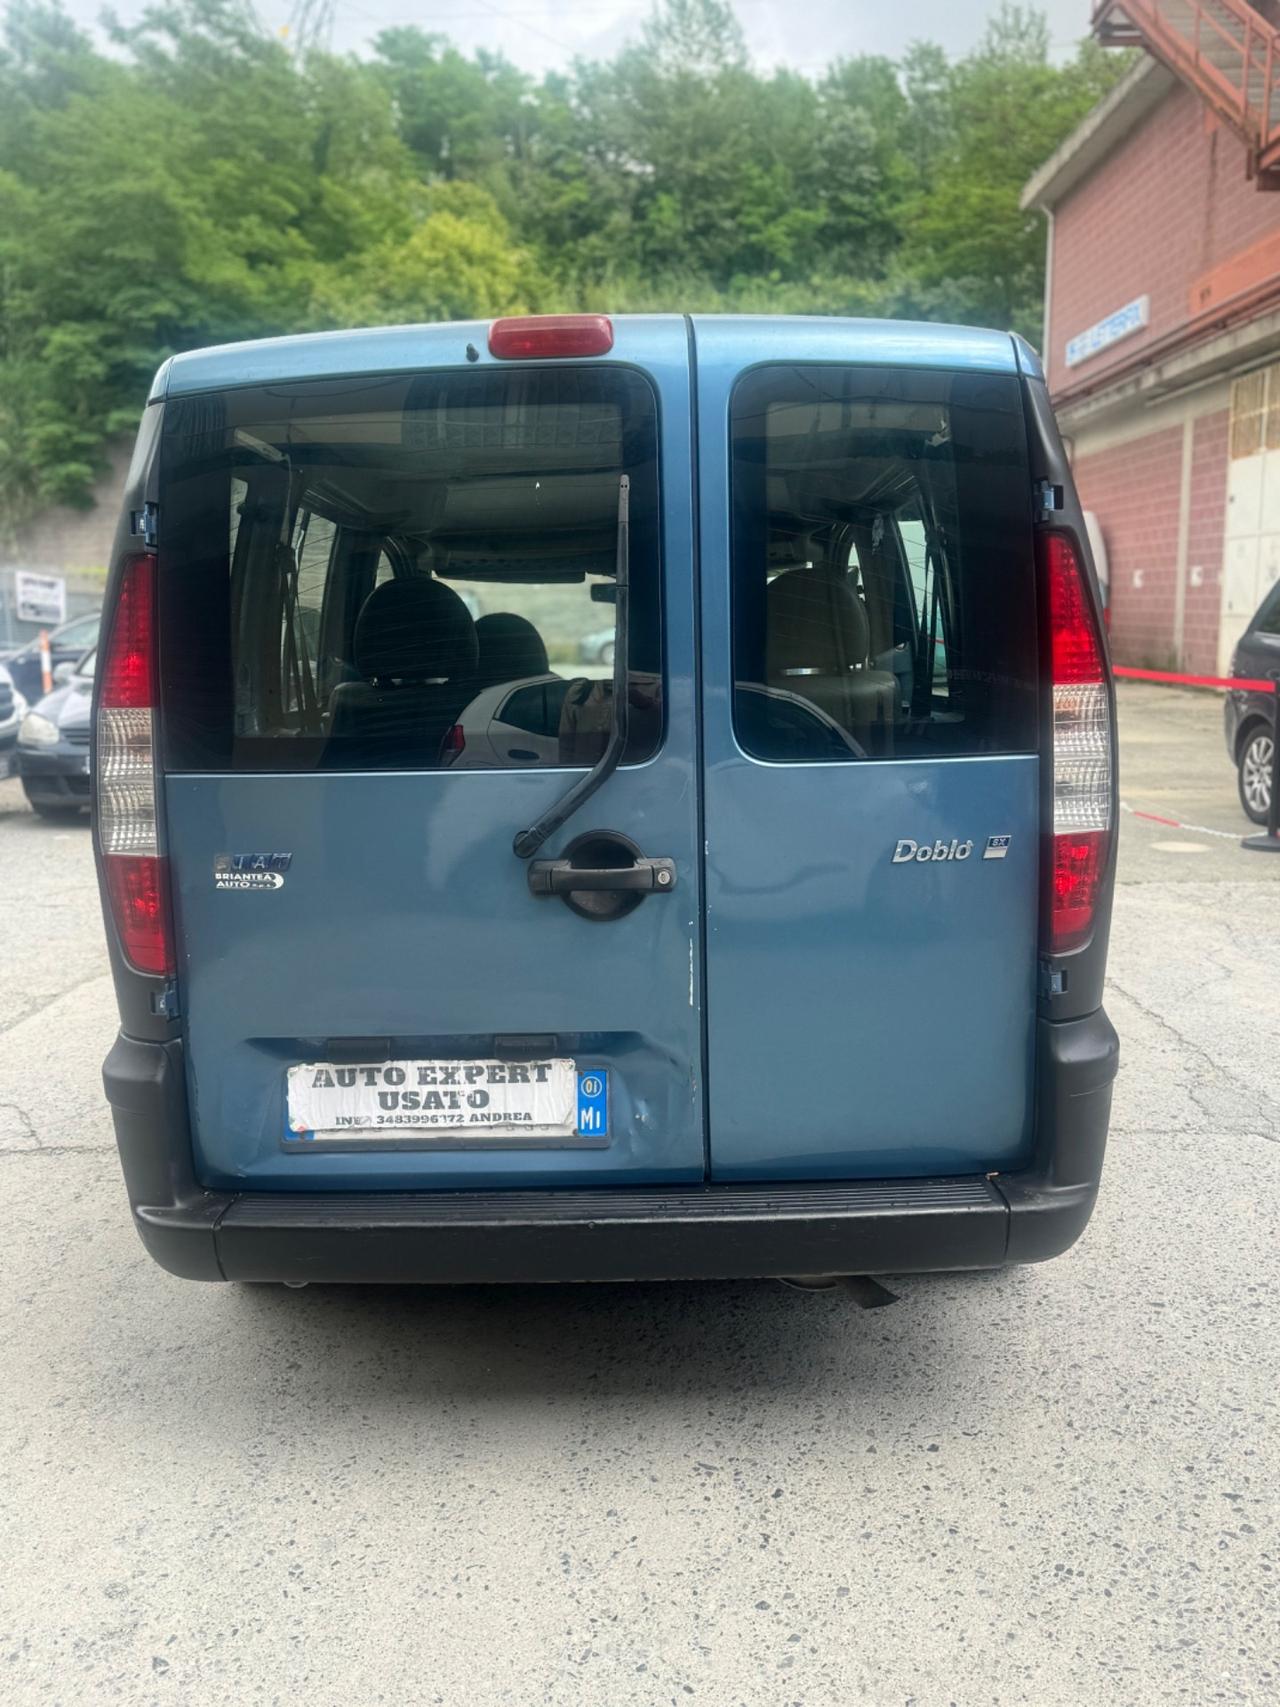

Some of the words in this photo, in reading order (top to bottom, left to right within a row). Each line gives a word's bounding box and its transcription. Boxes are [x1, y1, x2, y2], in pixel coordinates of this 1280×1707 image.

[214, 853, 293, 872] IAT
[215, 872, 272, 880] BRIANTEA
[216, 880, 250, 888] AUTO
[311, 1066, 406, 1088] AUTO
[417, 1064, 552, 1086] EXPERT
[378, 1089, 490, 1111] USATO
[470, 1112, 532, 1123] ANDREA
[581, 1106, 601, 1130] MI
